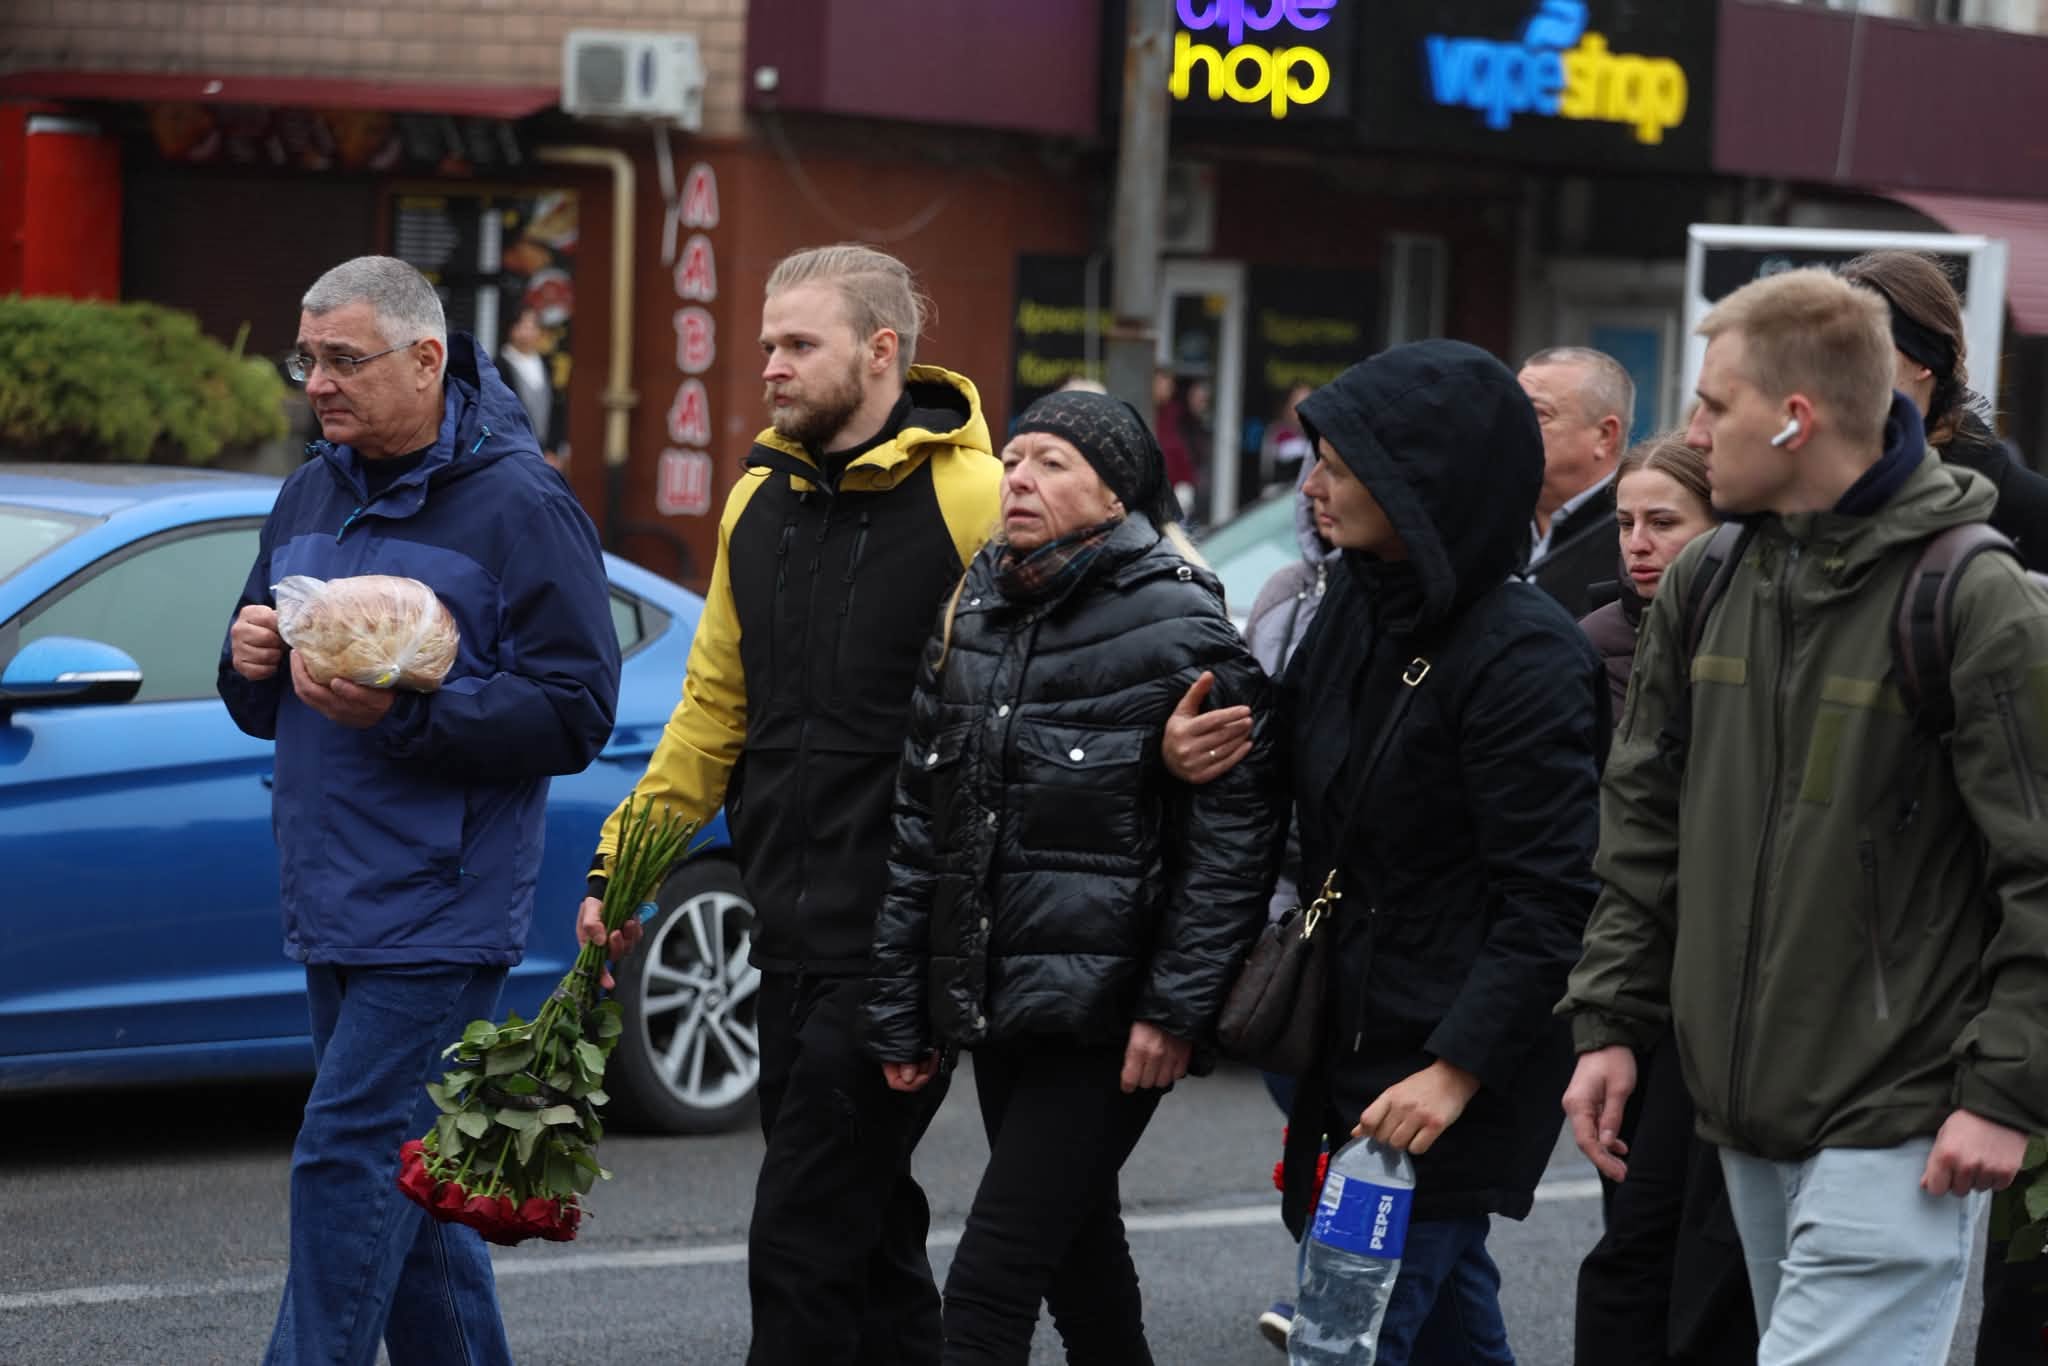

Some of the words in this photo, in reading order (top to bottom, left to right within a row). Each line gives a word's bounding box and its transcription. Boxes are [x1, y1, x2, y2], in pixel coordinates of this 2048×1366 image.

[1175, 0, 1337, 45] ape
[1168, 31, 1330, 119] hop
[656, 161, 720, 516] ЛАВАШ
[1369, 1195, 1394, 1250] PEPSI
